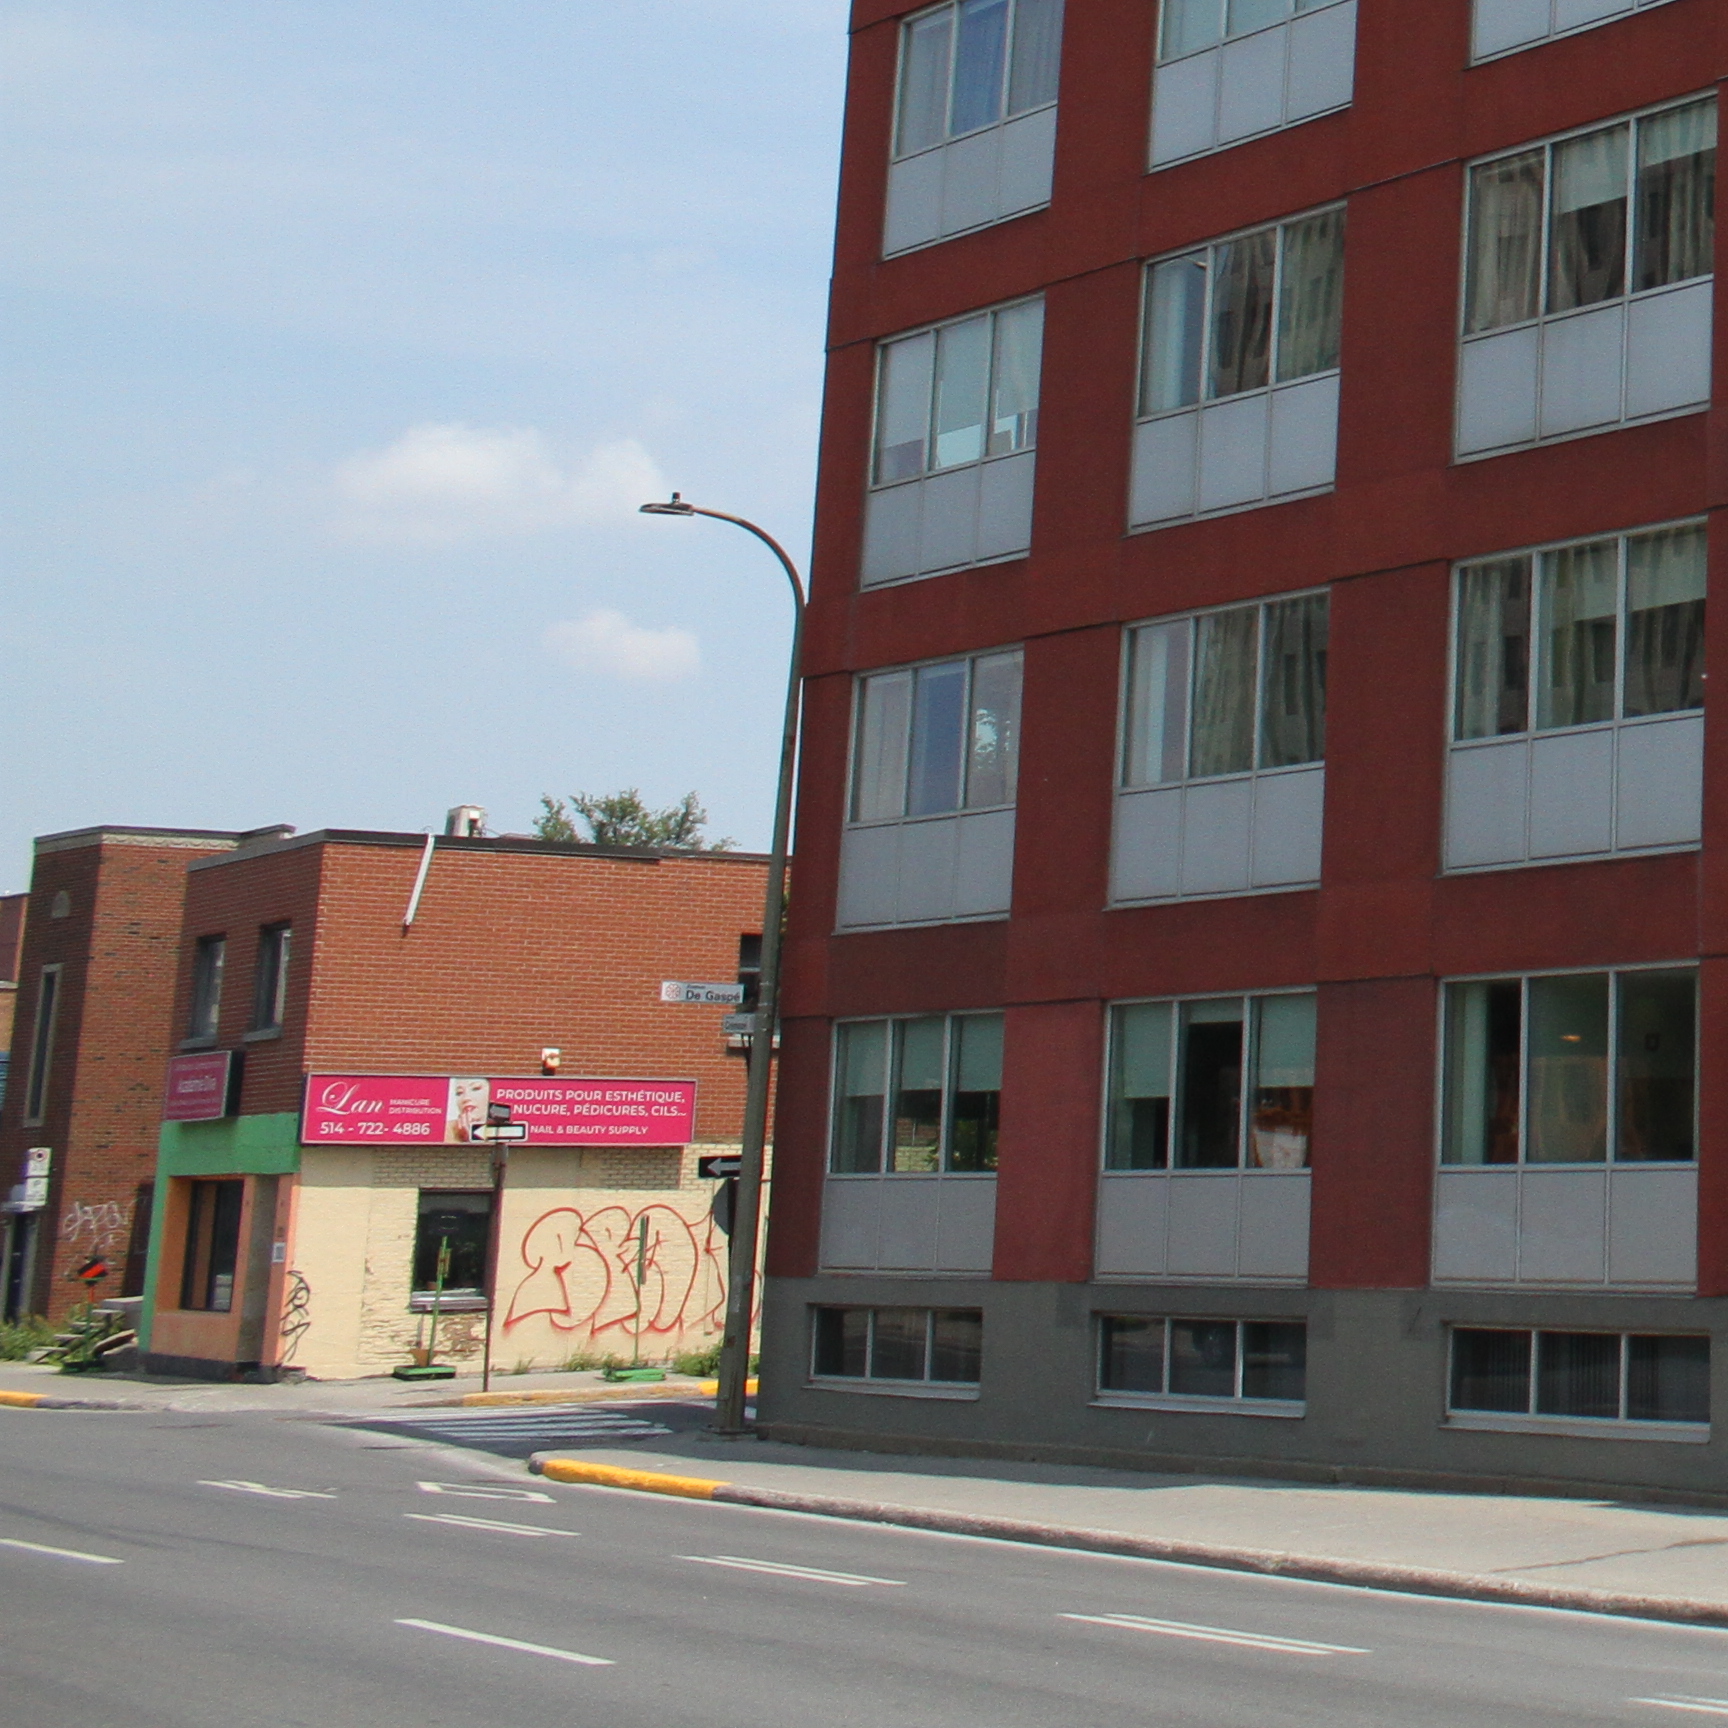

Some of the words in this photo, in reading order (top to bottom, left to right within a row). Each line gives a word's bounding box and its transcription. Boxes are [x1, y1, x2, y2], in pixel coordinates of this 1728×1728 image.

[686, 989, 701, 1000] De
[705, 990, 740, 1003] Gaspé
[316, 1081, 385, 1115] Lan
[496, 1088, 563, 1101] PRODUITS
[565, 1089, 602, 1101] POUR
[605, 1089, 685, 1103] ESTHÉTIQUE,
[388, 1106, 442, 1114] DISTRIBUTION
[574, 1102, 649, 1117] PÉDICURES,
[319, 1121, 345, 1135] 514
[393, 1122, 431, 1136] 4886
[530, 1125, 553, 1134] NAIL
[556, 1125, 564, 1134] &
[566, 1125, 606, 1134] BEAUTY
[608, 1125, 649, 1135] SUPPLY
